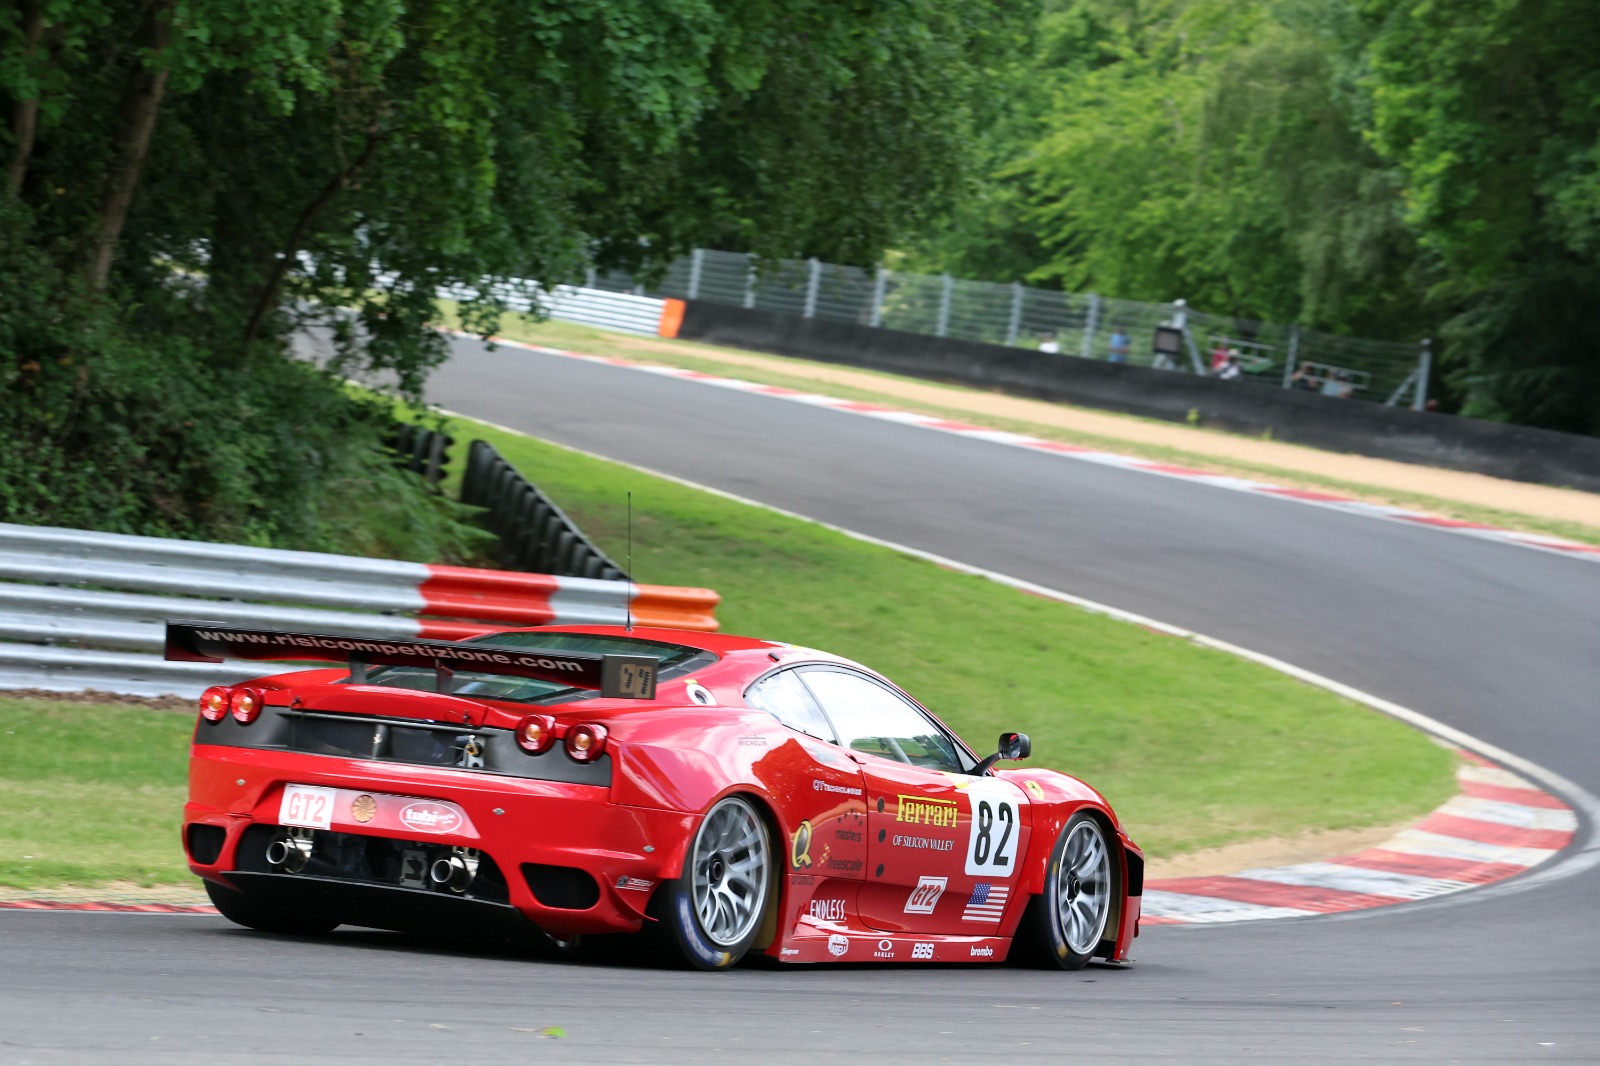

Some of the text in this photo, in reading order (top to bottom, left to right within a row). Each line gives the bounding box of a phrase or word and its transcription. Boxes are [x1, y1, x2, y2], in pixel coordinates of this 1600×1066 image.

[195, 629, 585, 673] www.risicompetizione.com
[287, 791, 327, 823] GT2
[405, 808, 438, 823] tubi
[896, 794, 959, 829] Ferrari
[835, 829, 862, 843] masters
[974, 800, 1013, 866] 82
[892, 834, 955, 852] OF SILICON VALLEY
[826, 856, 863, 872] freescale
[911, 883, 942, 908] GT2
[810, 899, 846, 920] ENDLESS
[911, 943, 935, 959] BBS
[970, 945, 993, 957] brembo
